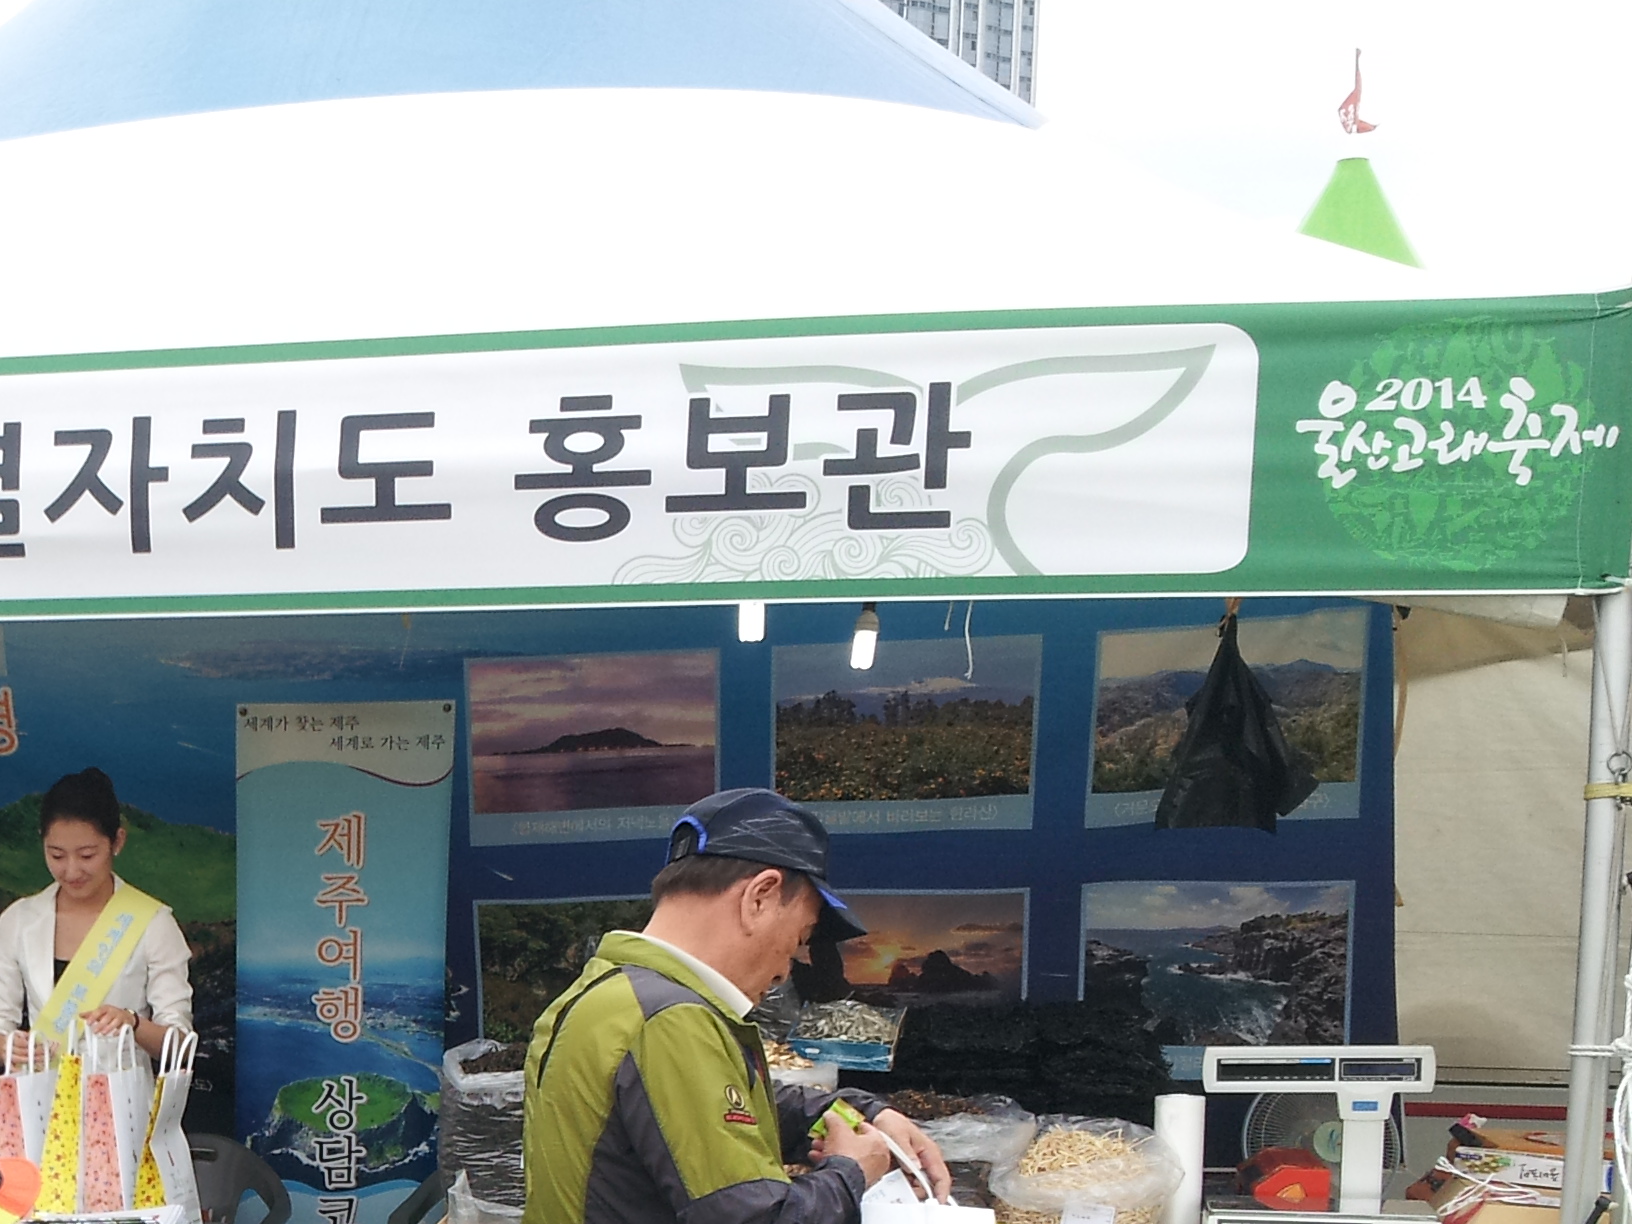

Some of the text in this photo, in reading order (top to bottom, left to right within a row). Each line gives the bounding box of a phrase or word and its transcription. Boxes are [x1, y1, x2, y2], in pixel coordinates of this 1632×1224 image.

[1364, 377, 1487, 411] 2014
[513, 381, 972, 543] 홍보관
[1295, 376, 1620, 489] 울산고래축제
[244, 715, 360, 732] 세계가 찾는 제주
[330, 733, 446, 751] 세계로 가는 제주
[311, 811, 369, 1044] 제주여행
